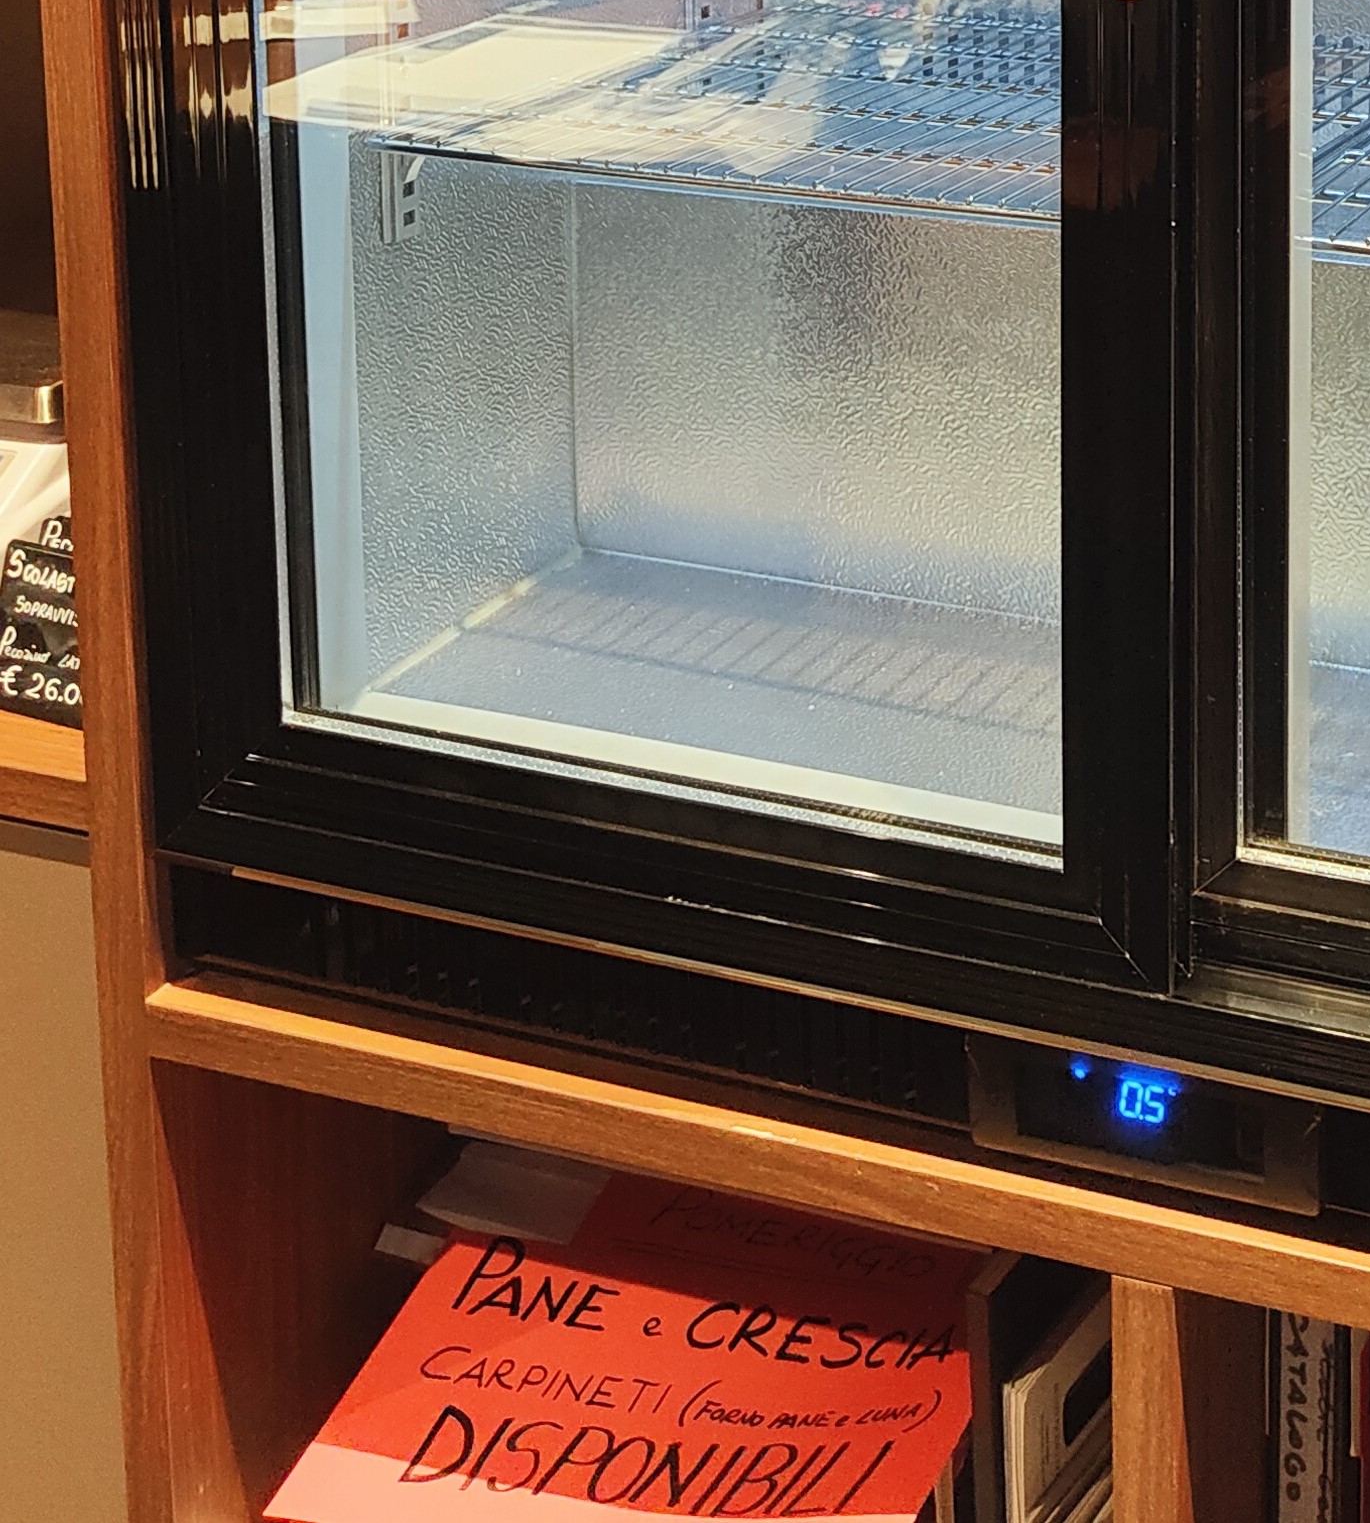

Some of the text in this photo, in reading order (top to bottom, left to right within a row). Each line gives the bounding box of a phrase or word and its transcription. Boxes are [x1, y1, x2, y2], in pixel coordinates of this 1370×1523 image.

[0, 664, 83, 707] € 26.0
[451, 1235, 955, 1370] PANE e CRESCIA
[419, 1345, 673, 1414] CARPINETI
[397, 1404, 896, 1519] DISPONIBILI
